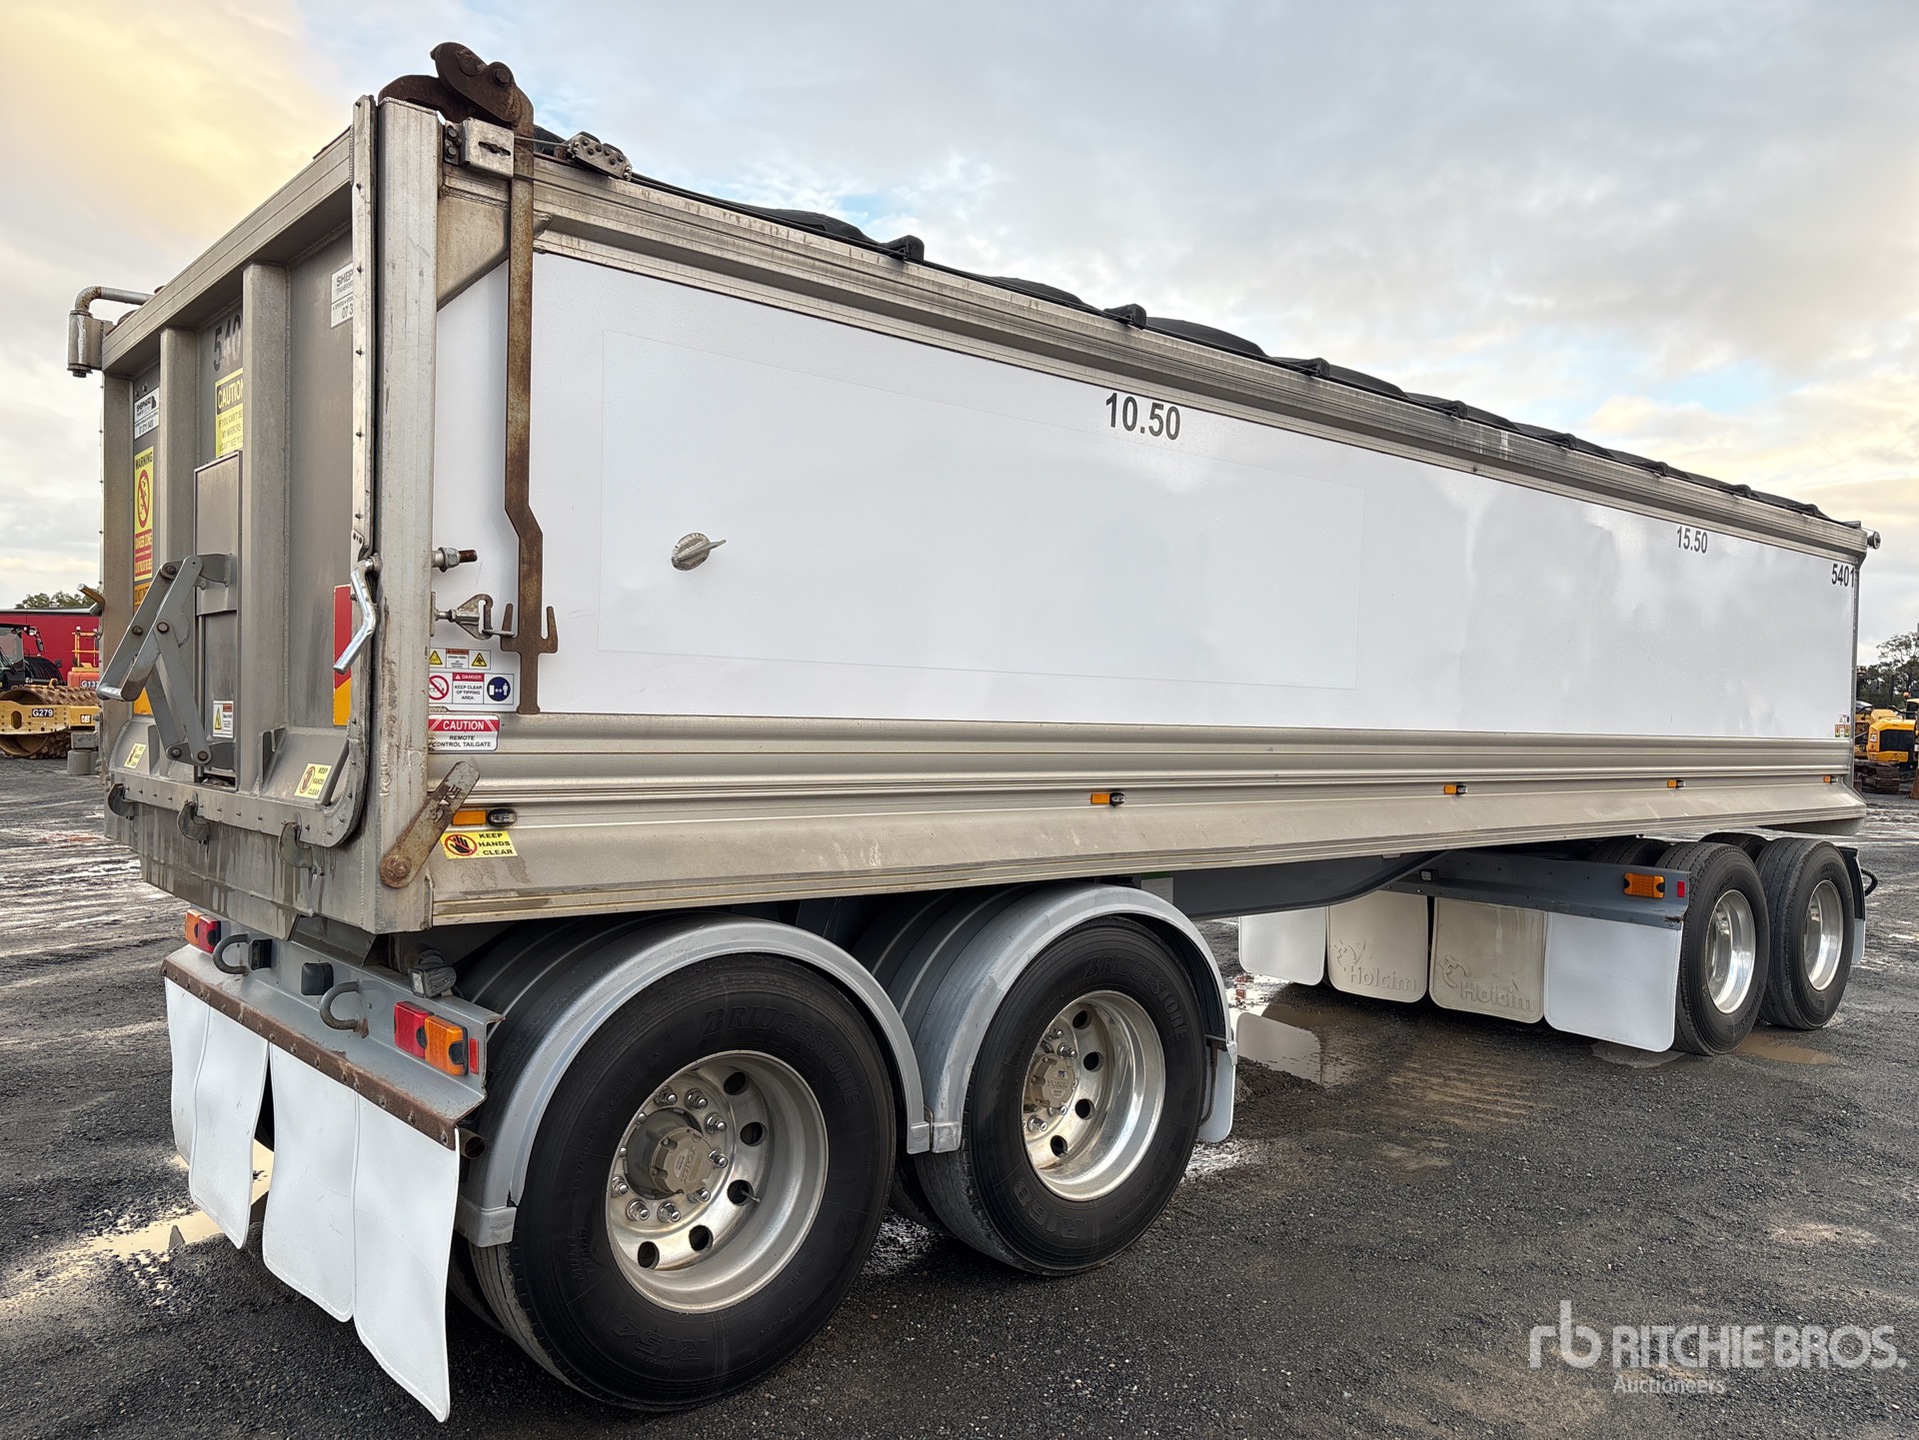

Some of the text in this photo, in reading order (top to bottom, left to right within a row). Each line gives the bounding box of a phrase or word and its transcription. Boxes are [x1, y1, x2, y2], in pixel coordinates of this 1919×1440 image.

[1106, 392, 1181, 440] 10.50
[1677, 525, 1708, 554] 15.50
[1831, 563, 1855, 588] 5401
[32, 708, 53, 717] G279
[442, 720, 485, 731] CAUTION
[1350, 965, 1416, 993] Holcim
[1083, 955, 1188, 1041] BRIDGESTONE
[1460, 980, 1534, 1012] Holcim
[701, 1005, 862, 1107] BRIDGESTONE
